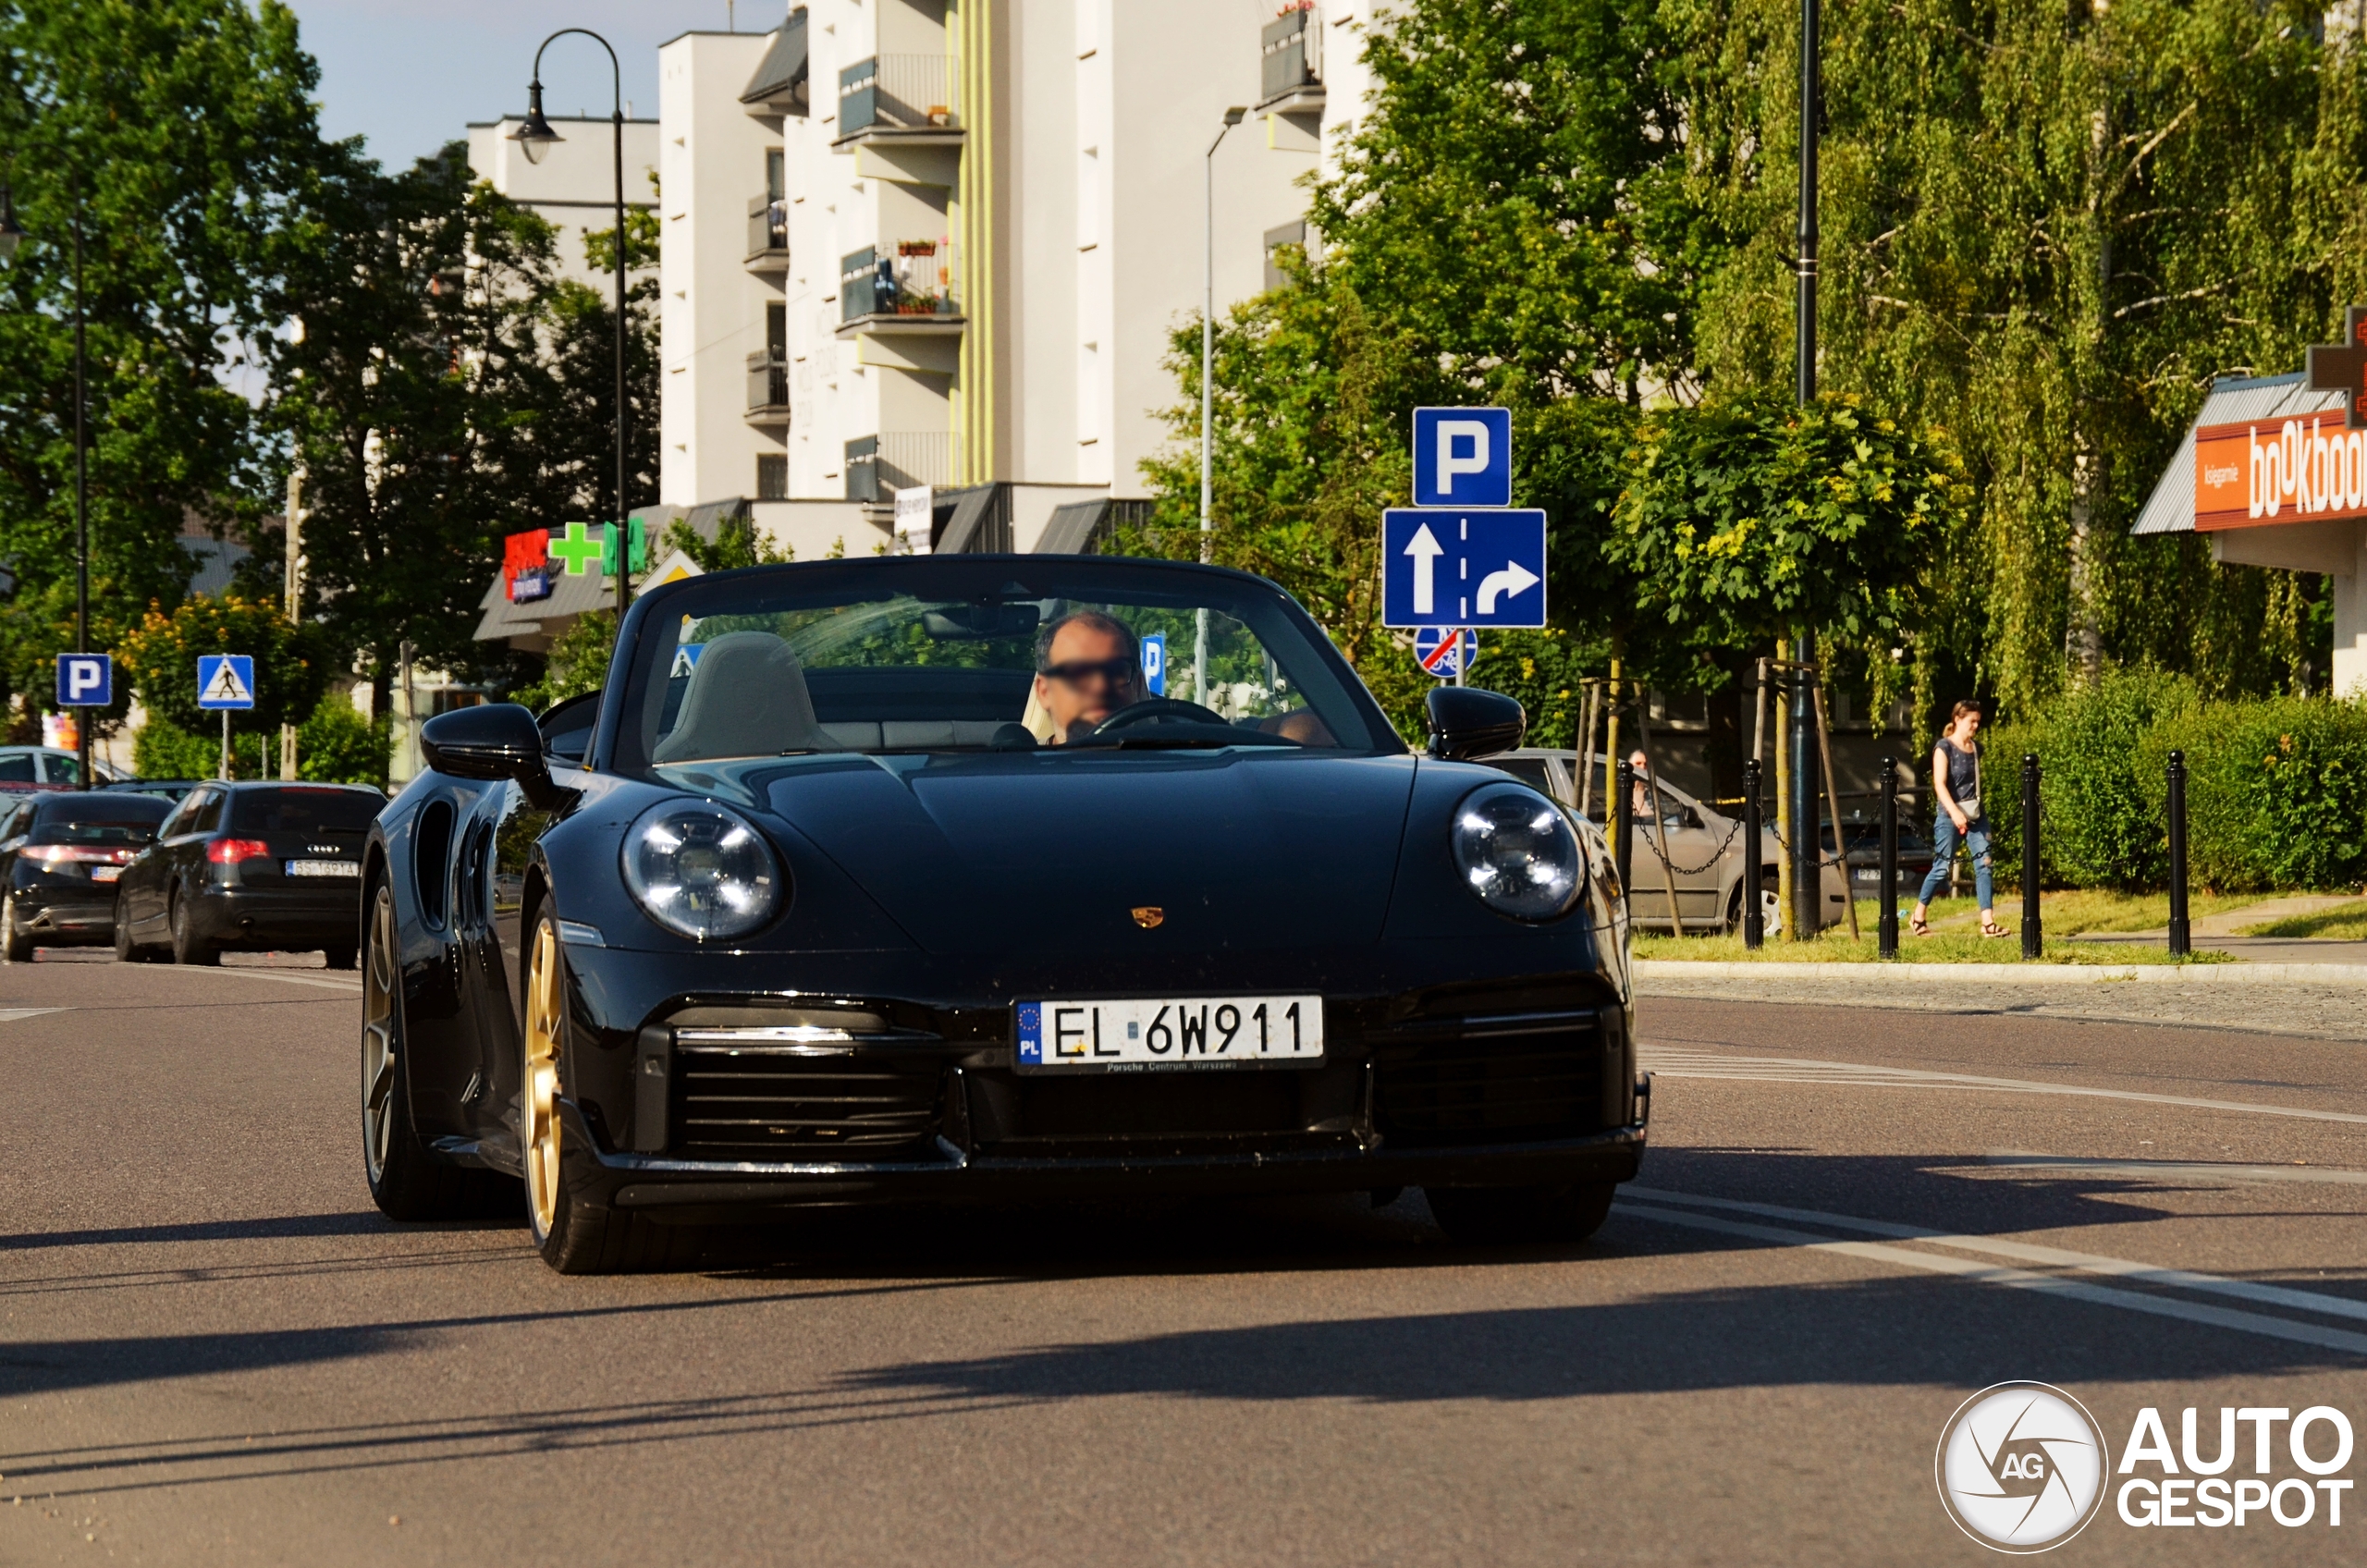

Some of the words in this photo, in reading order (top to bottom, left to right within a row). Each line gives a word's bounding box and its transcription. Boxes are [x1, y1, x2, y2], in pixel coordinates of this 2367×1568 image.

[1437, 420, 1490, 495] P
[69, 660, 101, 699] P
[1020, 1039, 1040, 1057] PL
[1054, 1006, 1121, 1058] EL
[1145, 1001, 1302, 1055] 6W911
[1107, 1062, 1144, 1072] Porsche
[1148, 1061, 1187, 1072] Centrum
[1193, 1060, 1237, 1071] Warszawa
